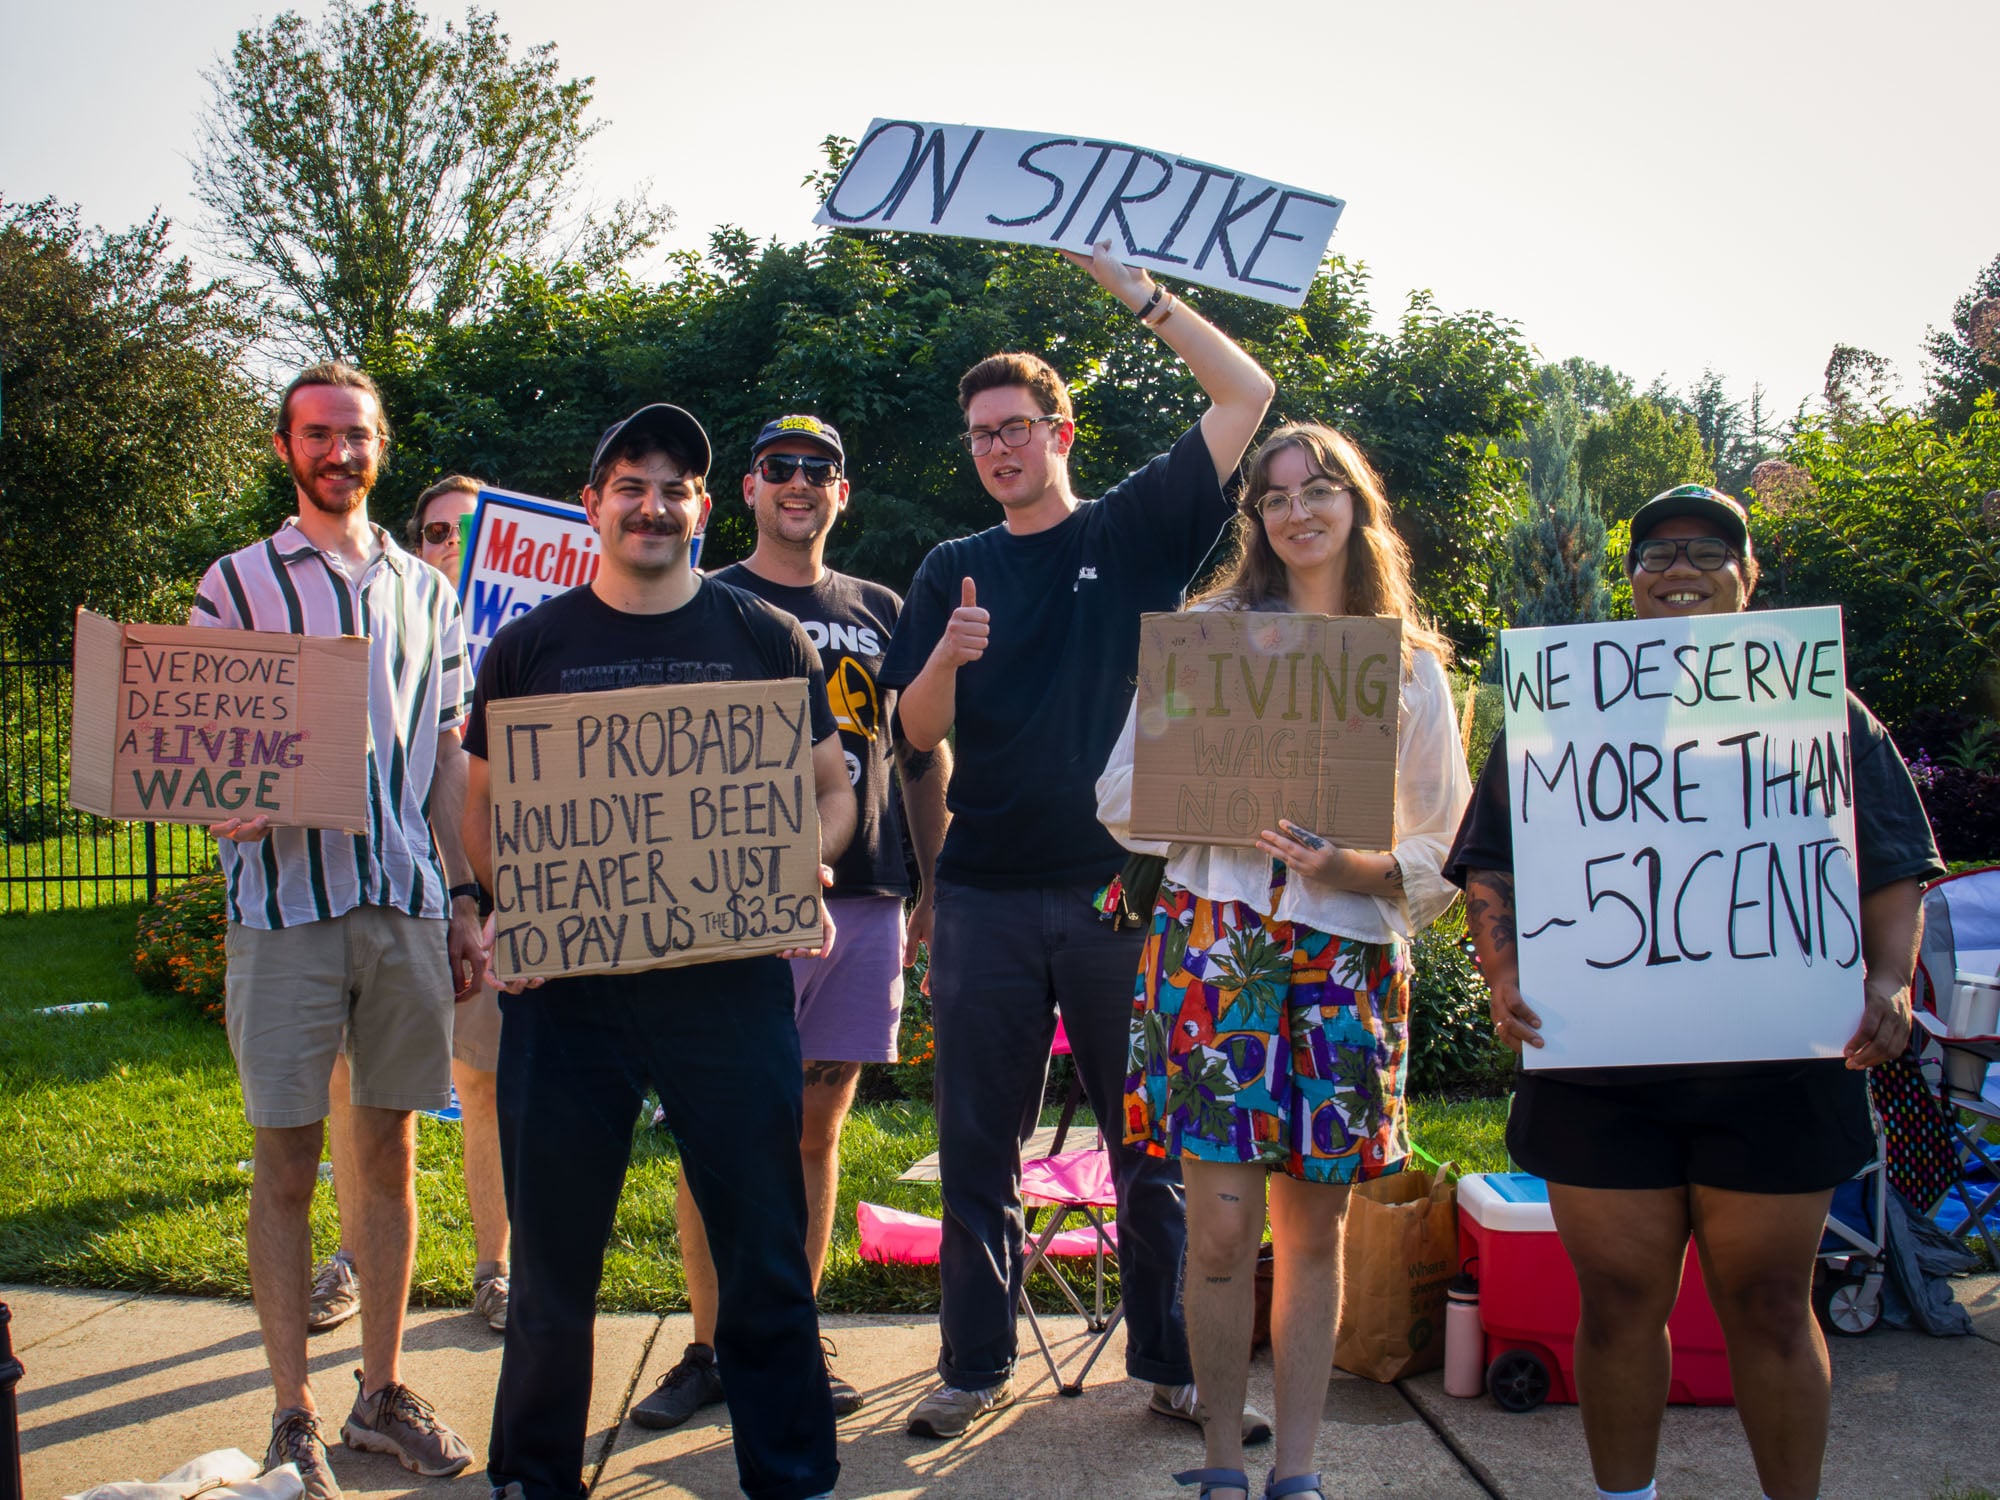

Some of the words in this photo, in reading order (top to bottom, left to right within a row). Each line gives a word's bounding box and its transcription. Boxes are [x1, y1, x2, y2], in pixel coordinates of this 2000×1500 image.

[825, 119, 985, 225] ON
[985, 138, 1338, 293] STRIKE
[122, 646, 295, 686] EVERYONE
[800, 621, 880, 656] ONS
[128, 690, 288, 720] DESERVES
[1165, 652, 1388, 722] LIVING
[1503, 641, 1570, 713] WE
[1593, 639, 1839, 712] DESERVE
[120, 729, 138, 753] A
[152, 725, 304, 769] LIVING
[506, 723, 553, 784] IT
[577, 699, 806, 778] PROBABLY
[1193, 725, 1340, 779] WAGE
[133, 768, 280, 810] WAGE
[1176, 781, 1339, 836] NOW!
[1522, 741, 1707, 826] MORE
[1717, 731, 1852, 830] THAN
[495, 792, 672, 856] WOULD'VE
[690, 775, 803, 838] BEEN
[495, 850, 678, 914] CHEAPER
[690, 845, 791, 896] JUST
[498, 921, 548, 973] TO
[557, 911, 628, 970] PAY
[642, 905, 696, 958] US
[699, 912, 730, 933] THE
[720, 892, 818, 941] $3.50
